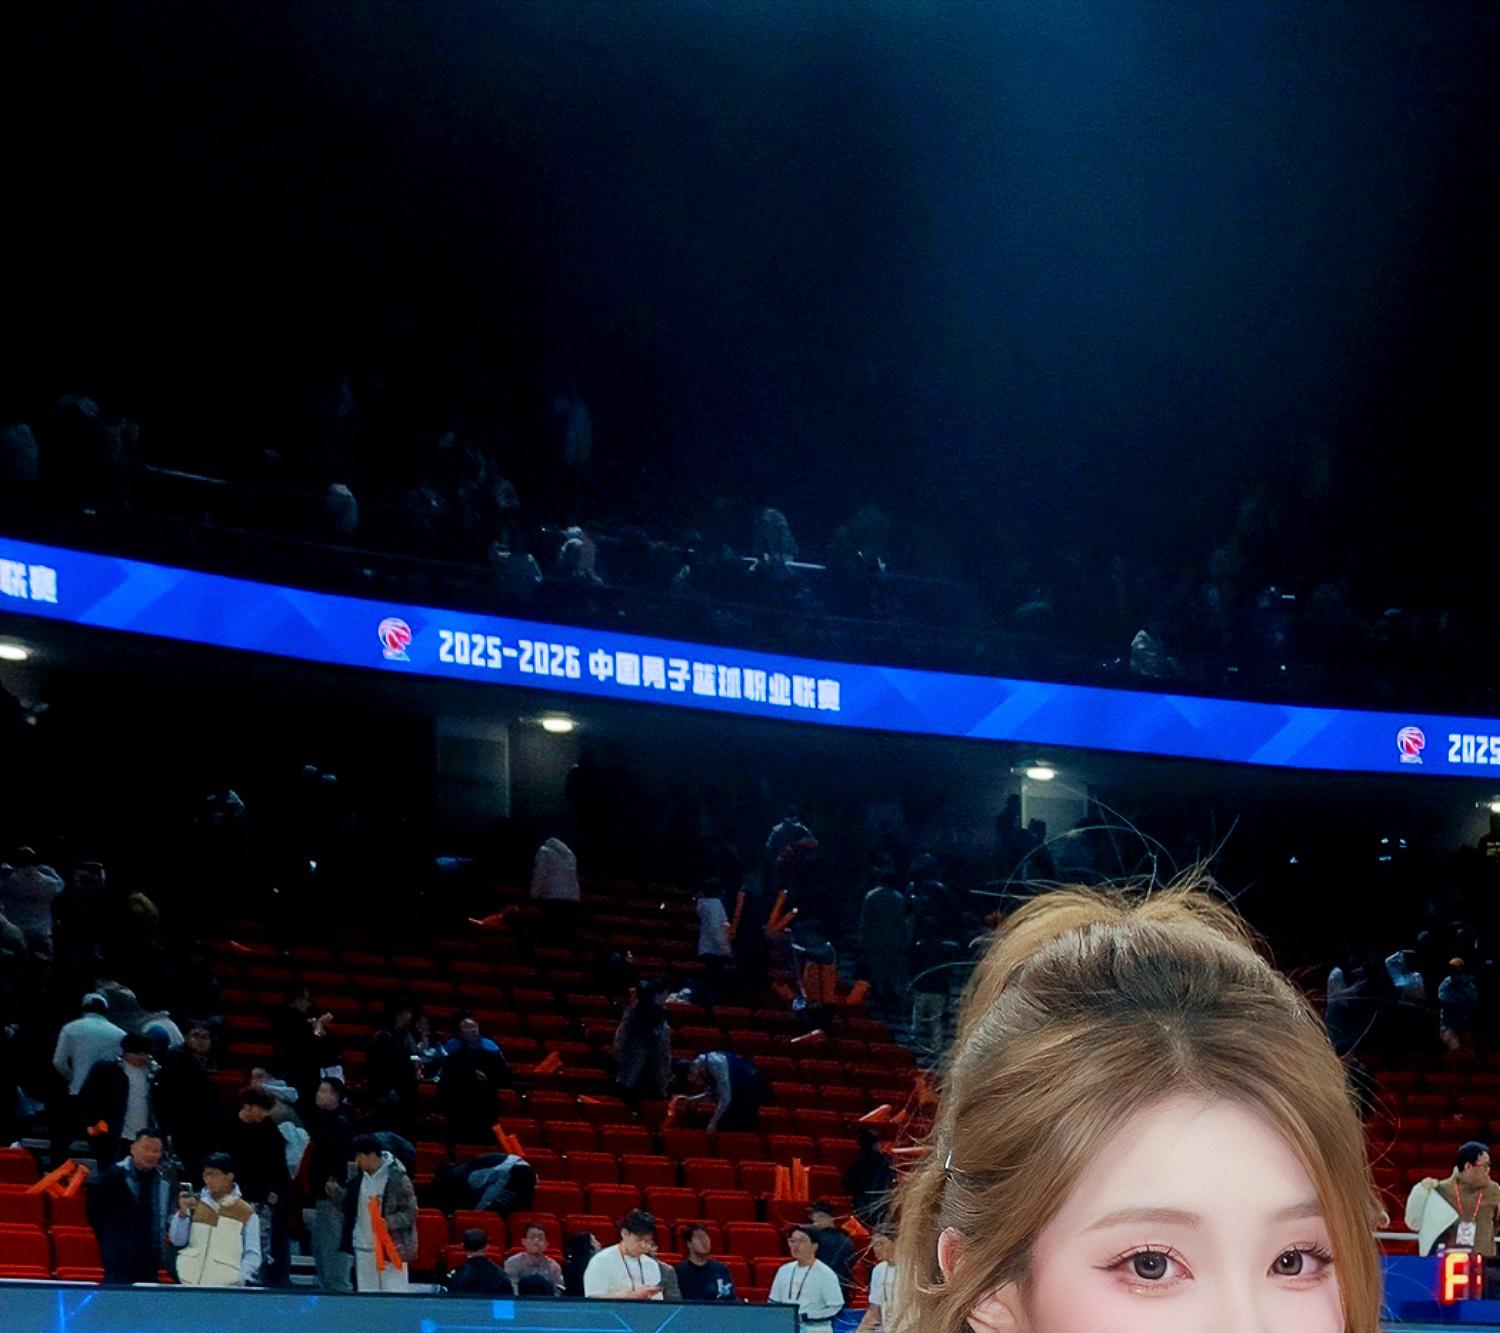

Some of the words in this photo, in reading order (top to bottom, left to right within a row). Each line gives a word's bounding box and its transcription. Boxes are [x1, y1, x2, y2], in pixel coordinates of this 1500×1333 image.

[439, 630, 581, 679] 2025-2026
[589, 648, 841, 711] 中国男子篮球职业联赛
